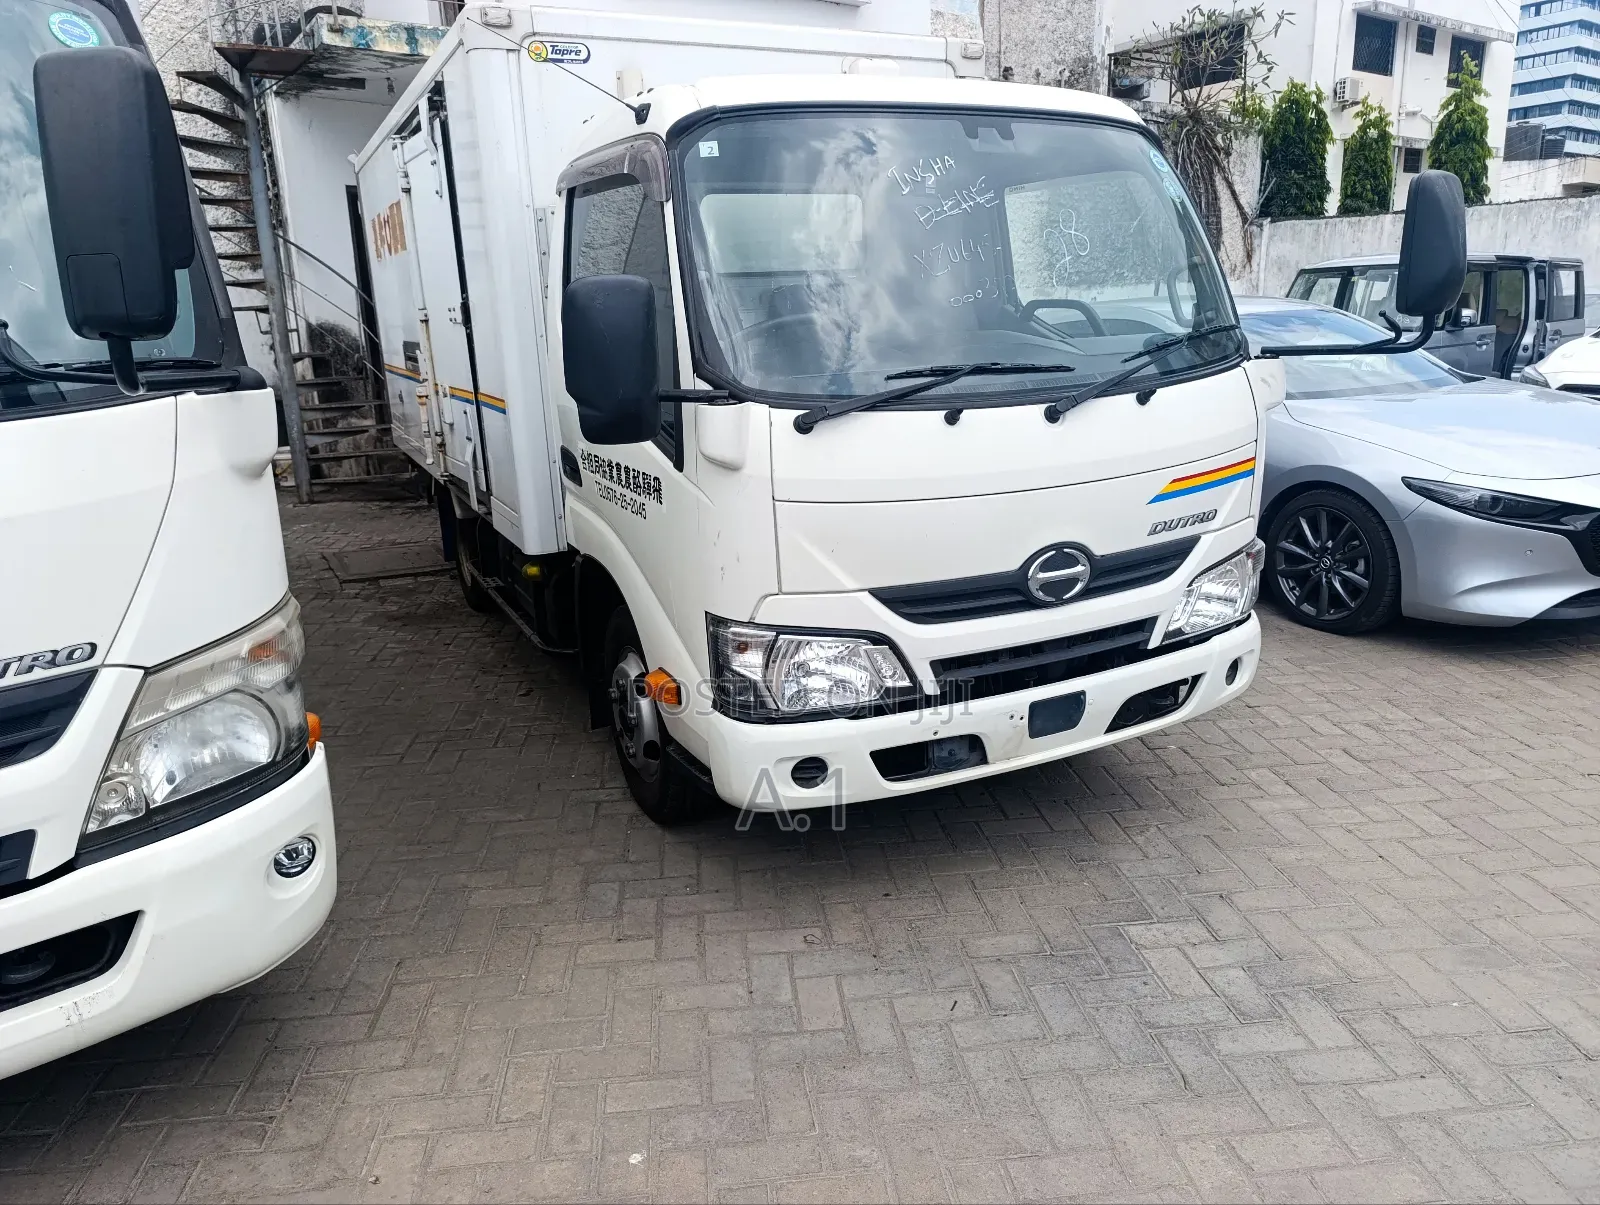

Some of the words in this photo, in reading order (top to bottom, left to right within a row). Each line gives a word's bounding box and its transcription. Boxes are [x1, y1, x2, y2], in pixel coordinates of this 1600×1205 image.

[550, 44, 582, 57] Topre
[707, 146, 715, 155] 2
[888, 155, 955, 195] INSHA
[1147, 508, 1218, 536] DUTRO
